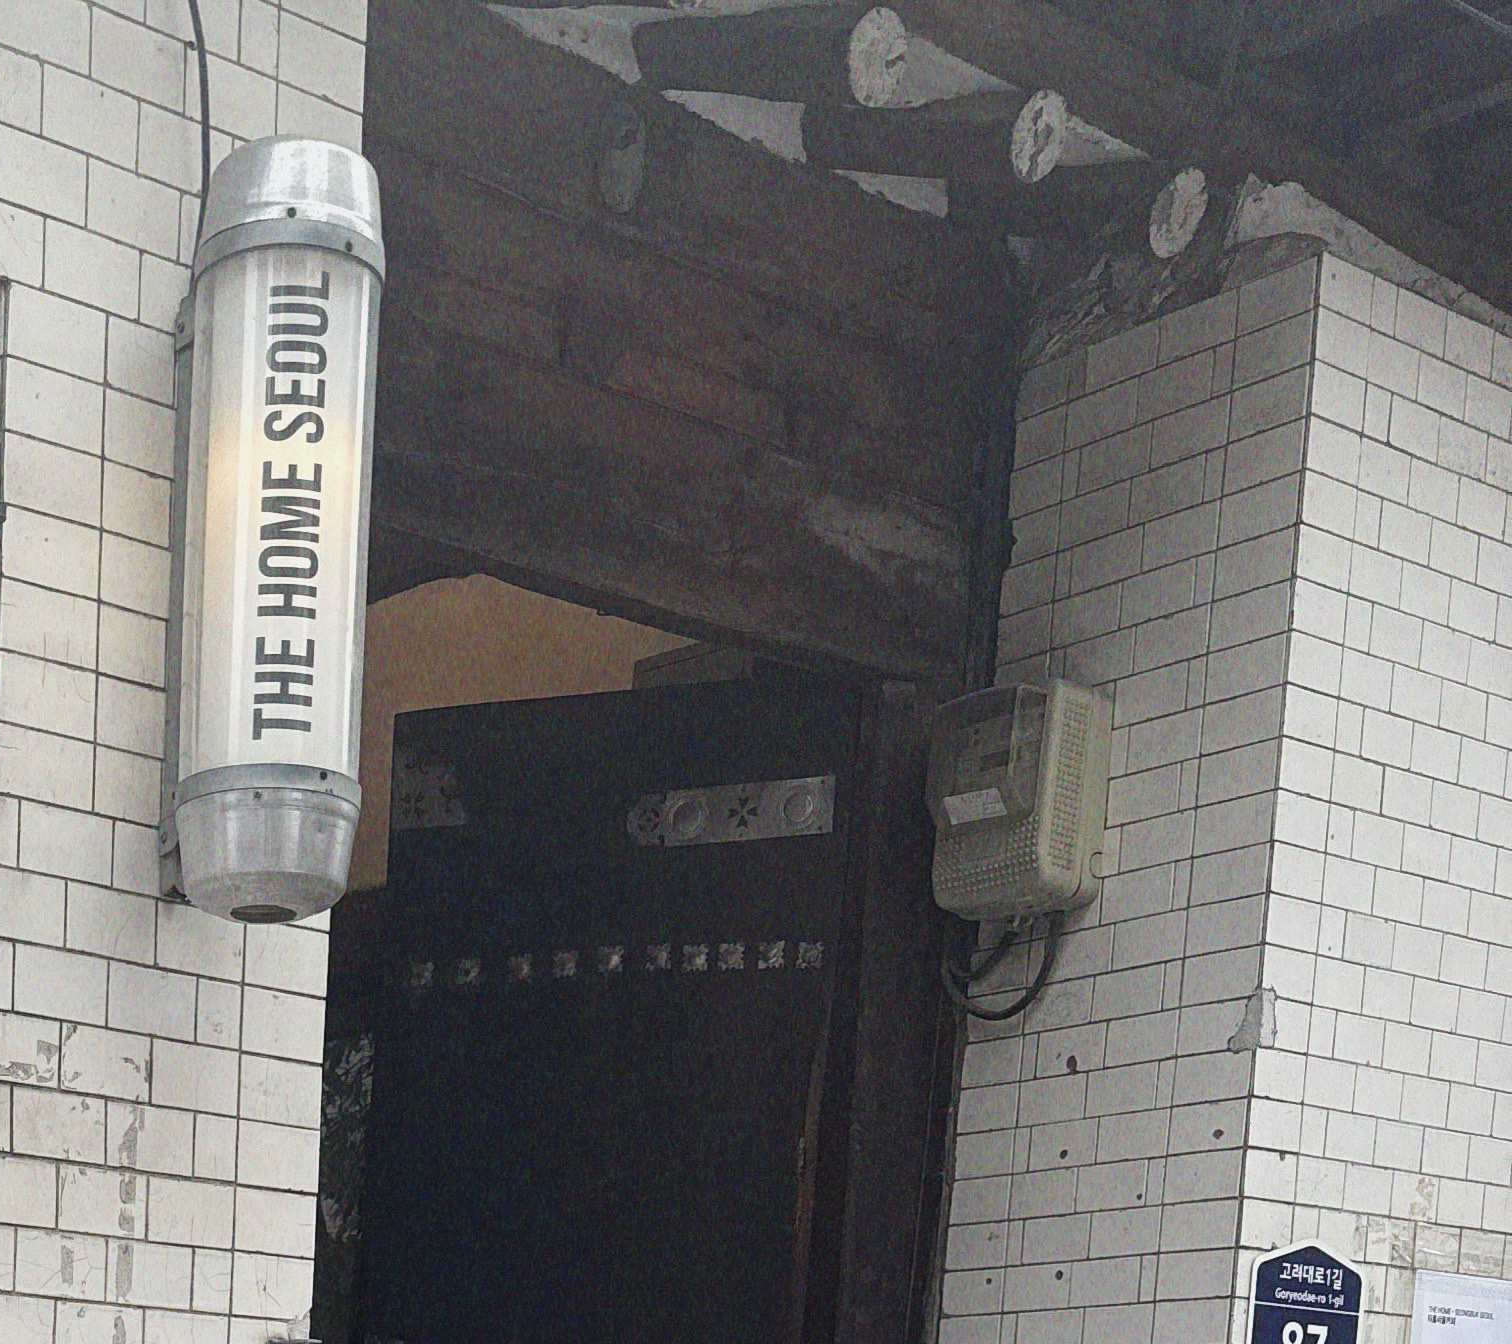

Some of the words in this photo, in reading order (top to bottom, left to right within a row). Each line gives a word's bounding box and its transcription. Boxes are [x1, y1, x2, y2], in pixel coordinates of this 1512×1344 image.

[263, 270, 330, 444] SEOUL
[256, 460, 323, 620] HOME
[252, 636, 315, 741] THE
[1279, 1262, 1343, 1291] 고려대로1길
